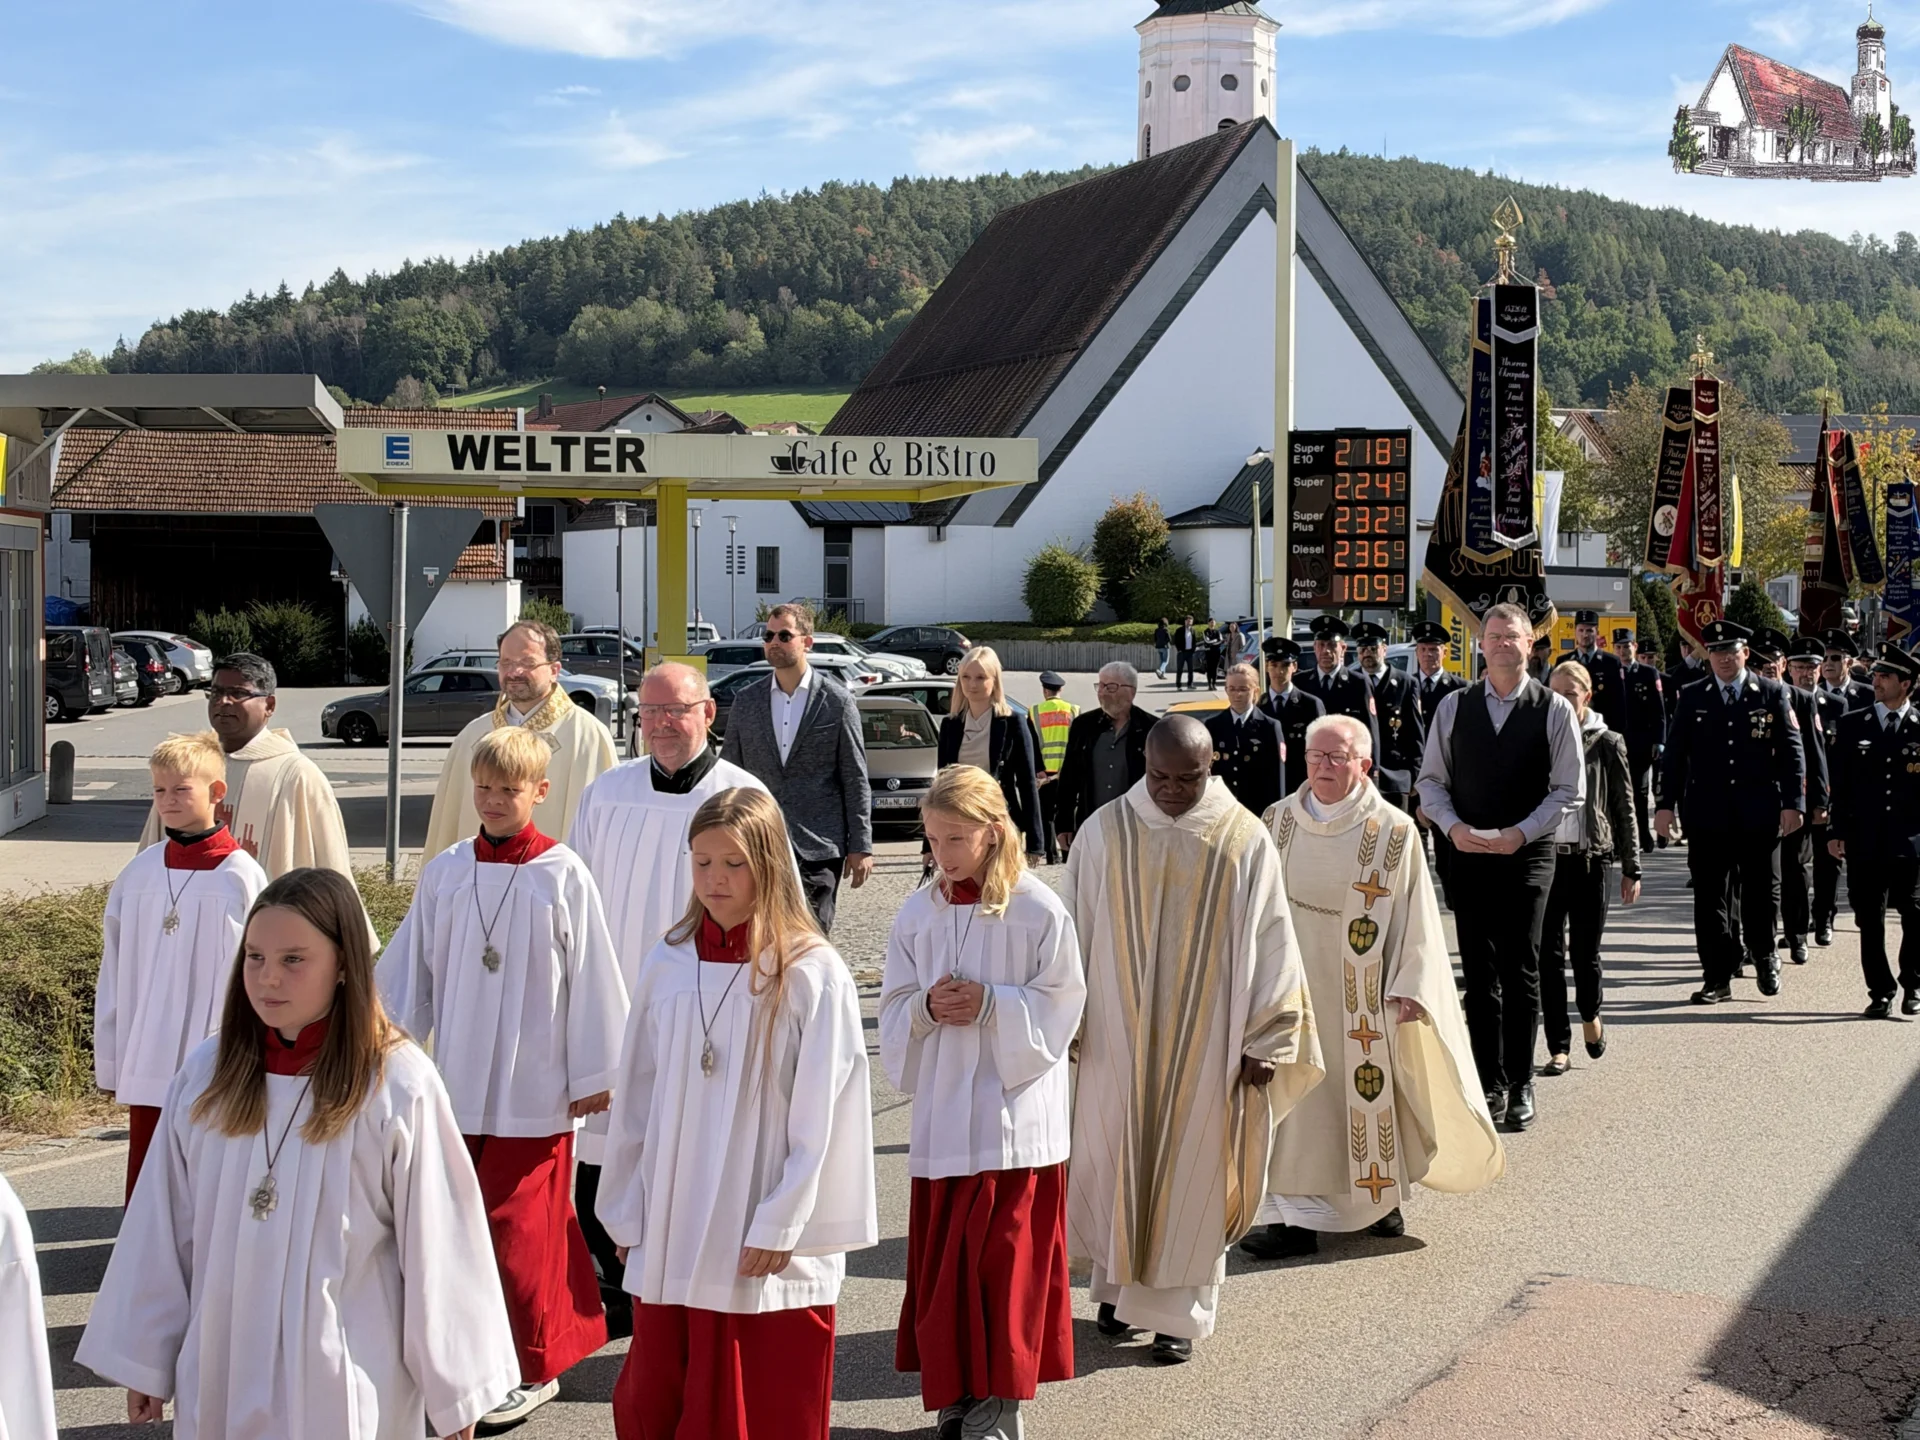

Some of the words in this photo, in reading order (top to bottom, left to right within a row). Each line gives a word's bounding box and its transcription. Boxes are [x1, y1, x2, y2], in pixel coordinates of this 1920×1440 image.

[447, 434, 647, 473] WELTER
[1294, 444, 1324, 456] Super
[869, 442, 892, 476] &
[904, 442, 996, 477] Bistro
[1294, 478, 1324, 488] Super
[1293, 511, 1324, 522] Super
[1293, 522, 1314, 532] Plus
[1292, 544, 1325, 554] Diesel
[1292, 578, 1317, 588] Auto
[1292, 589, 1313, 599] Gas
